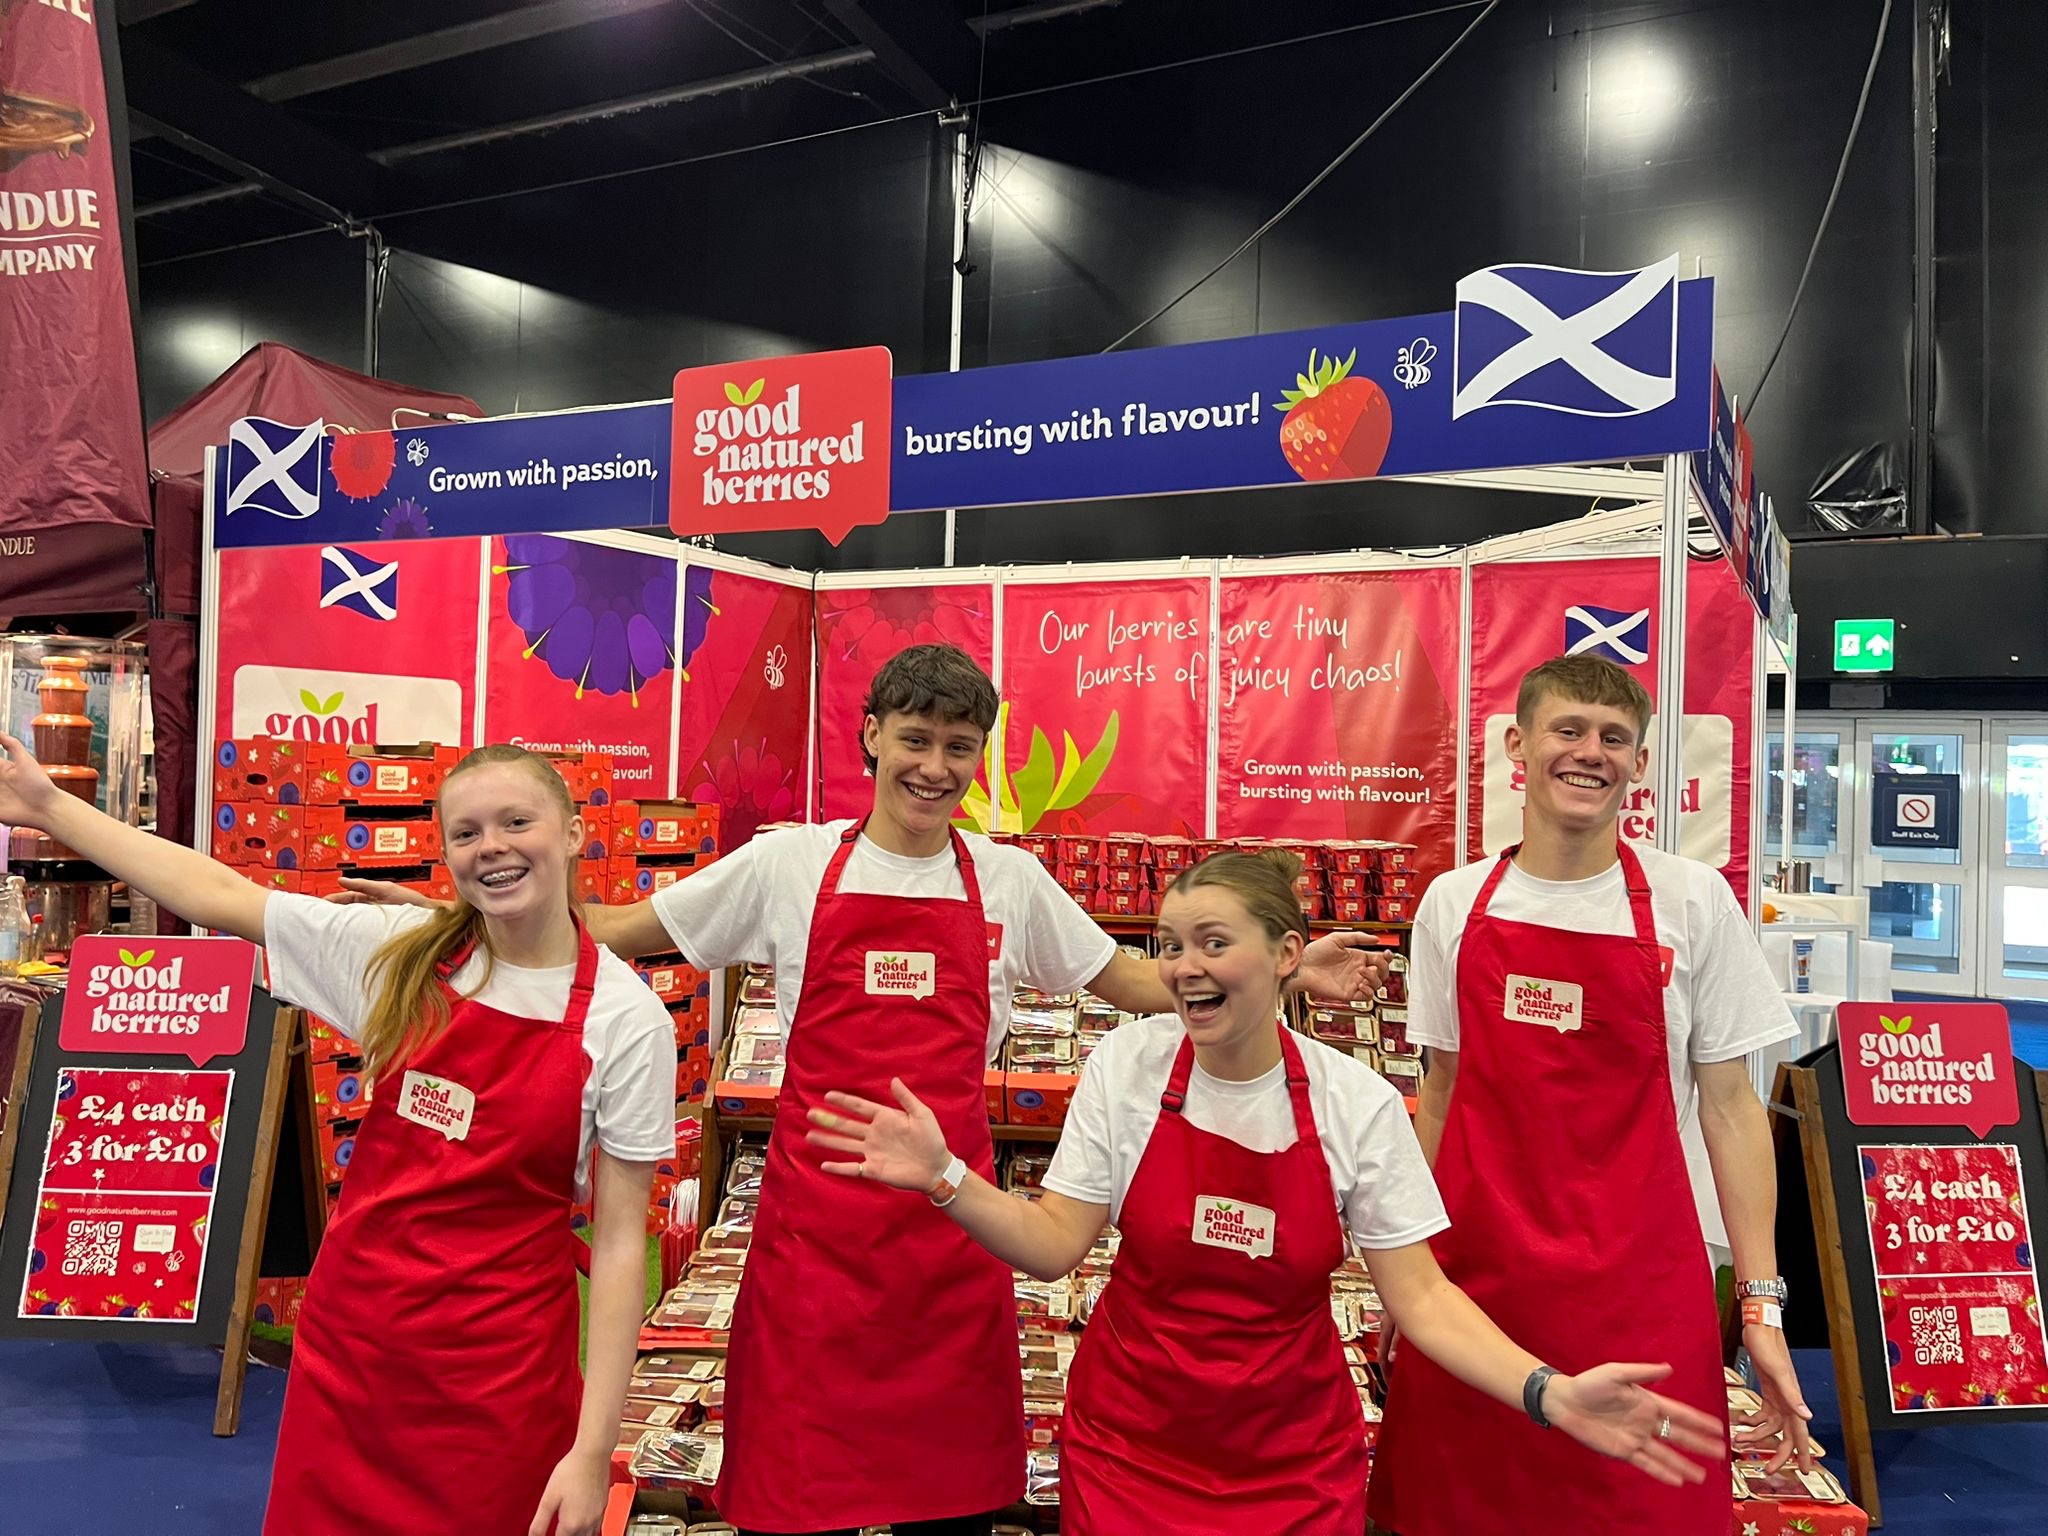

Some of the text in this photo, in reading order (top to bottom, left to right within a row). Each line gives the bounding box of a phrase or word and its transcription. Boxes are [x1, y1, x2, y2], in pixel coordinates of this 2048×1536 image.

[693, 384, 801, 456] good
[905, 391, 1261, 456] bursting with flavour!
[718, 421, 864, 473] natured
[428, 453, 658, 492] Grown with passion,
[703, 466, 830, 506] berries
[1039, 604, 1348, 654] Our berries are tiny
[1076, 649, 1402, 707] bursts of juicy chaos!
[1244, 759, 1425, 782] Grown with passion,
[1240, 782, 1430, 805] bursting with flavour!
[1923, 832, 1940, 841] Only
[86, 956, 183, 997] good
[873, 959, 909, 975] good
[882, 970, 927, 981] natured
[877, 977, 917, 989] berries
[1514, 986, 1552, 1001] good
[107, 985, 230, 1013] natured
[1516, 1003, 1561, 1021] berries
[1523, 999, 1573, 1013] natured
[91, 1005, 200, 1035] berries
[1859, 1023, 1944, 1068] good
[1881, 1052, 1996, 1082] natured
[410, 1083, 450, 1104] good
[1870, 1075, 1973, 1105] berries
[78, 1095, 206, 1125] £4 each
[410, 1102, 453, 1127] berries
[418, 1098, 464, 1121] natured
[63, 1135, 207, 1165] 3 for £10
[1884, 1173, 2003, 1206] £4 each
[66, 1206, 178, 1216] www.goodnaturedberries.com
[1203, 1208, 1244, 1225] good
[1205, 1226, 1253, 1246] berries
[1213, 1221, 1265, 1240] natured
[1885, 1215, 2015, 1249] 3 for £10
